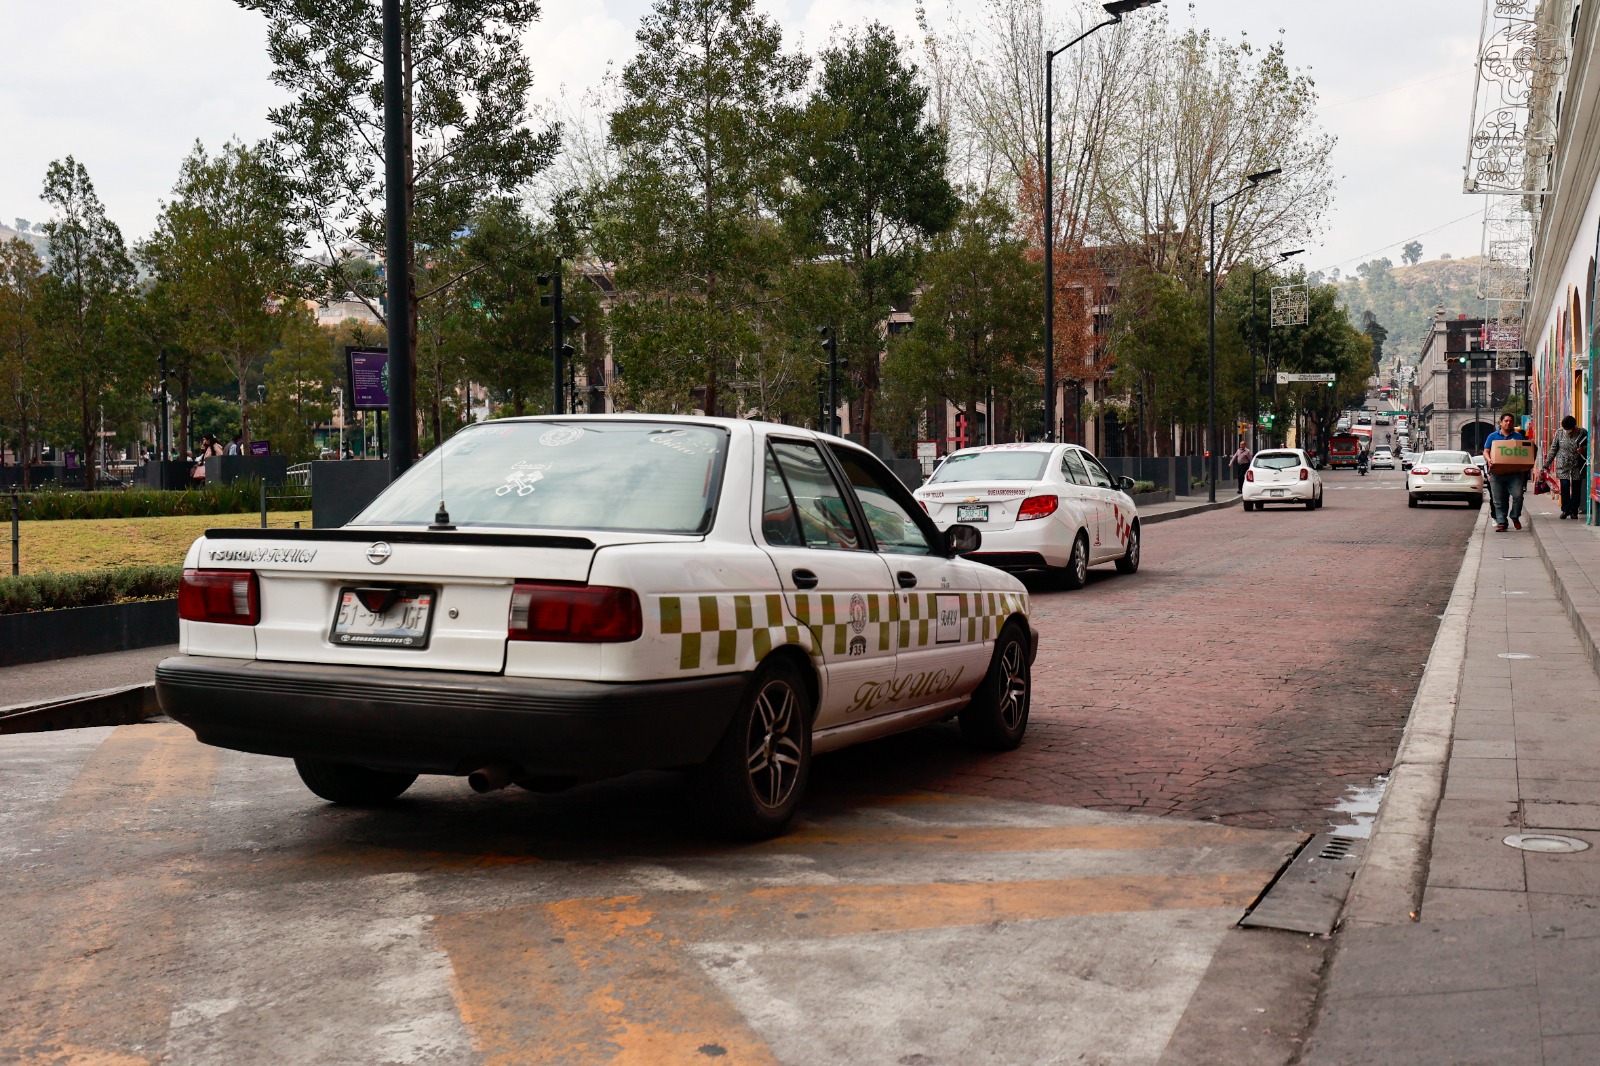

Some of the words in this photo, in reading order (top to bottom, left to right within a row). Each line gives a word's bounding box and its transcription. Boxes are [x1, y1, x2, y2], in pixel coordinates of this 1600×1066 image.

[1497, 446, 1529, 457] Totis
[208, 550, 251, 561] TSURU
[350, 635, 403, 643] AGUASCALIENTES
[853, 645, 862, 656] 35
[846, 665, 965, 713] TOLUCA
